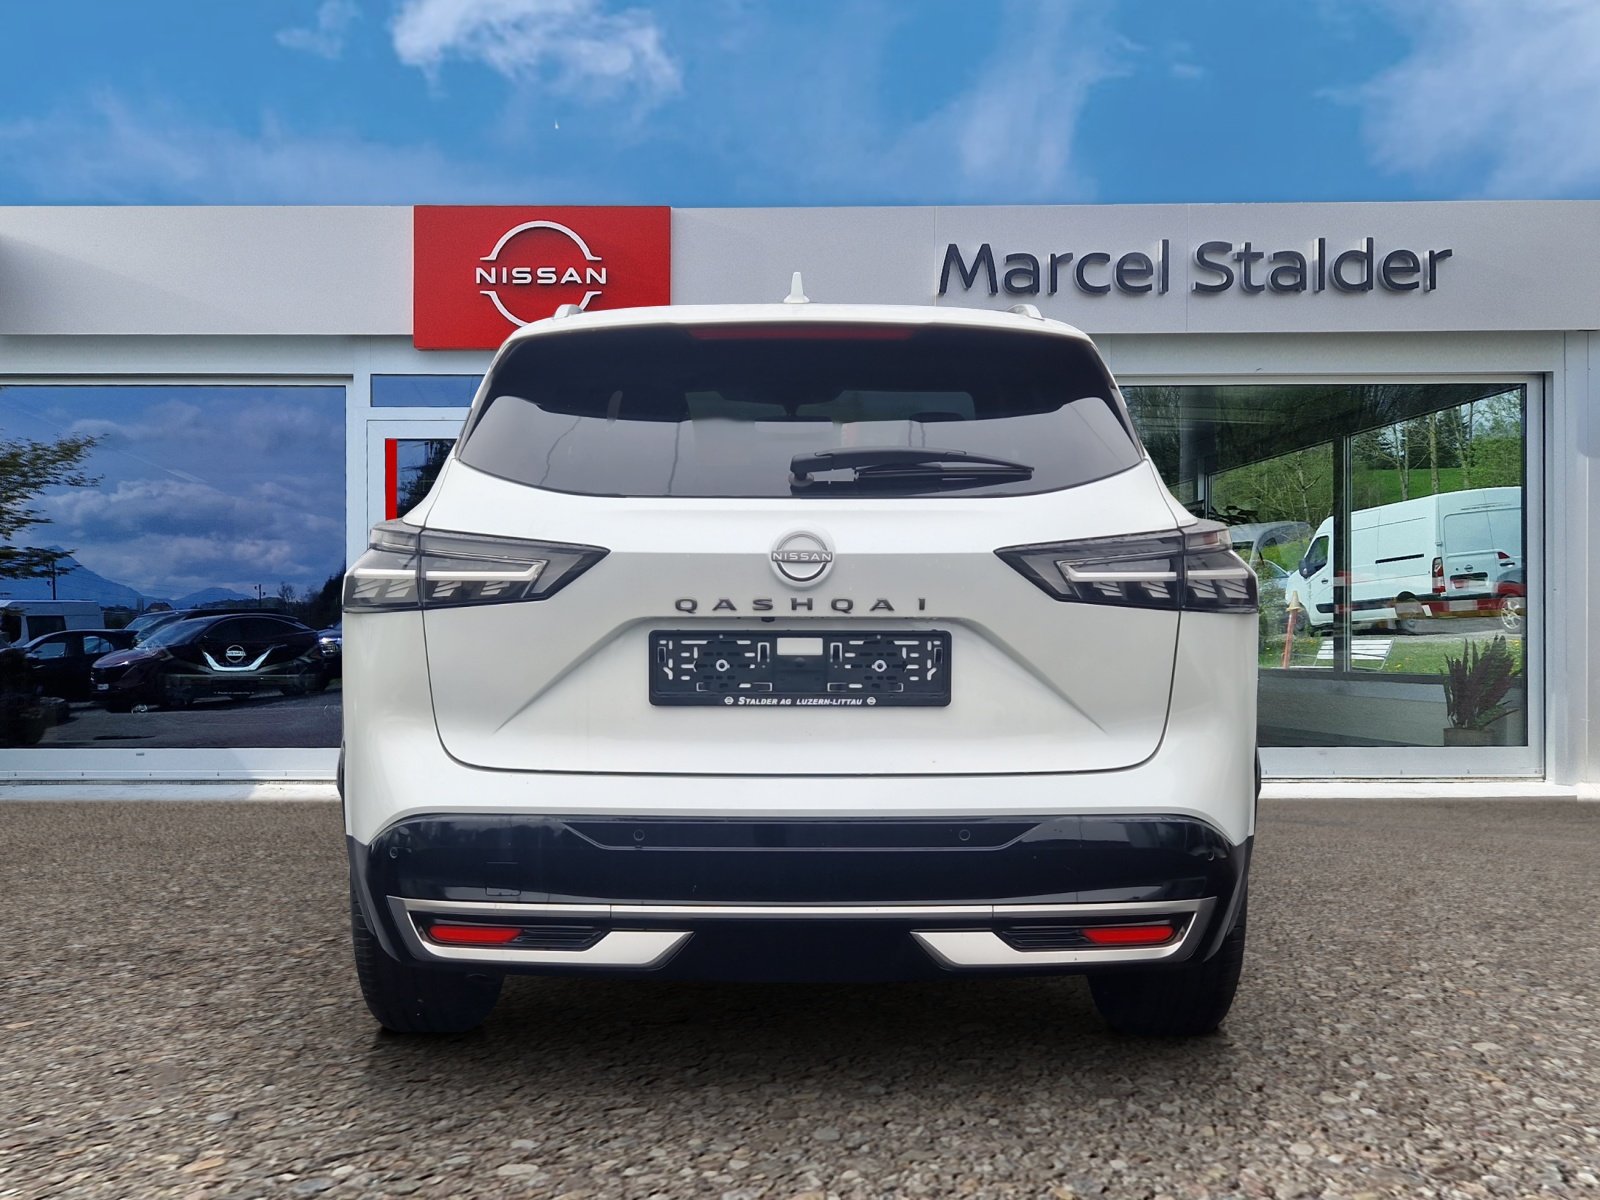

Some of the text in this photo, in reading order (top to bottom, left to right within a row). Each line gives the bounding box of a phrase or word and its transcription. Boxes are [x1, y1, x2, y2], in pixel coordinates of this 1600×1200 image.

[938, 237, 1453, 296] Marcel Stalder
[475, 267, 607, 284] NISSAN
[772, 552, 831, 561] NISSAN
[674, 598, 927, 614] QASHQAI
[738, 696, 863, 706] STALDER AG LUZERN-LITTAU
